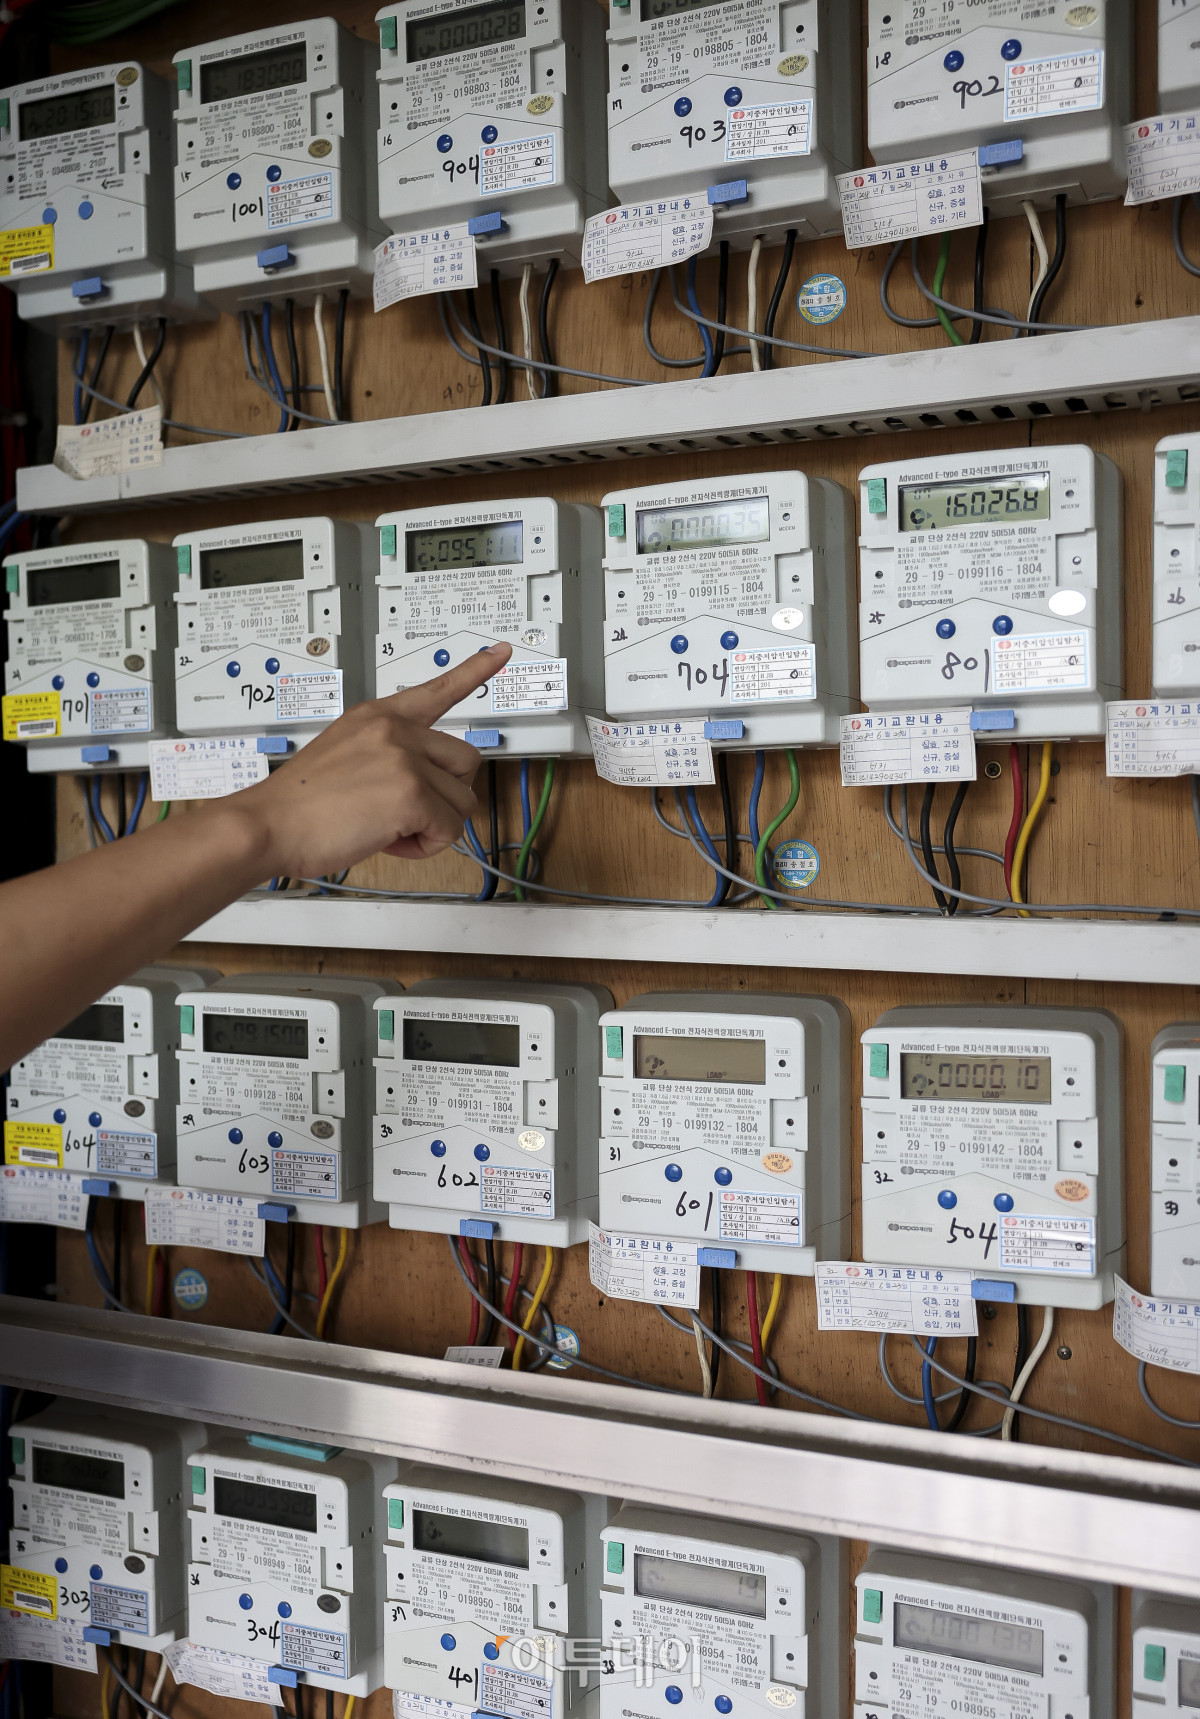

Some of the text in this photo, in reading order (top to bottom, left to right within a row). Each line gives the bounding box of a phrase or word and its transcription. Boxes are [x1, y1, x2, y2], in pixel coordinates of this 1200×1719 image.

[647, 32, 768, 69] 29 19 0198805 1804
[876, 52, 891, 68] 18
[412, 75, 520, 107] 29 19 0198803 1804
[953, 76, 1004, 109] 902
[205, 118, 302, 146] 29 19 0198800 1804
[384, 134, 392, 146] 16
[680, 120, 726, 148] 903
[181, 172, 191, 182] 15
[443, 154, 479, 184] 904
[233, 197, 263, 222] 1001
[899, 472, 933, 482] Advanced
[935, 471, 959, 479] E-type
[636, 498, 667, 508] Advanced
[668, 496, 689, 504] E-type
[910, 536, 925, 544] 교류
[928, 534, 944, 543] 단상
[946, 532, 967, 541] 2선식
[969, 531, 989, 539] 220V
[1018, 527, 1037, 535] 60Hz
[647, 557, 660, 565] 교류
[662, 556, 676, 564] 단상
[678, 554, 696, 562] 2선식
[699, 552, 716, 560] 220V
[742, 548, 758, 556] 60Hz
[905, 563, 1042, 583] 29 19 0199116 1804
[643, 581, 764, 602] 29 19 0199115 1804
[1167, 587, 1185, 604] 26
[411, 600, 517, 618] 29 19 0199114 1804
[869, 611, 885, 624] 25
[205, 614, 299, 632] 29 19 0199113 1804
[383, 643, 393, 656] 23
[180, 657, 192, 666] 22
[678, 658, 729, 697] 704
[942, 649, 989, 693] 801
[242, 685, 275, 710] 702
[63, 693, 88, 723] 701
[945, 765, 960, 773] 기타
[900, 1043, 935, 1051] Advanced
[937, 1044, 960, 1052] E-type
[208, 1086, 303, 1102] 29 19 0199128 1804
[642, 1083, 656, 1091] 교류
[658, 1084, 672, 1092] 단상
[674, 1085, 692, 1093] 2선식
[695, 1086, 712, 1094] 220V
[737, 1088, 754, 1096] 60Hz
[407, 1095, 513, 1112] 29 19 0199131 1804
[912, 1104, 927, 1113] 교류
[930, 1105, 945, 1114] 단상
[948, 1106, 968, 1114] 2선식
[971, 1107, 990, 1115] 220V
[1019, 1109, 1038, 1117] 60Hz
[183, 1114, 194, 1126] 29
[639, 1116, 758, 1133] 29 19 0199132 1804
[381, 1124, 392, 1138] 30
[65, 1130, 96, 1168] 604
[610, 1147, 620, 1161] 31
[907, 1140, 1043, 1156] 29 19 0199142 1804
[239, 1149, 269, 1173] 603
[438, 1164, 479, 1187] 602
[874, 1170, 893, 1184] 32
[676, 1191, 713, 1231] 601
[947, 1218, 998, 1259] 504
[217, 1548, 227, 1561] 29
[236, 1552, 245, 1561] 19
[294, 1561, 312, 1575] 1804
[191, 1573, 199, 1585] 36
[60, 1586, 90, 1613] 303
[418, 1586, 523, 1614] 29 19 0198950 1804
[392, 1606, 406, 1621] 37
[248, 1620, 280, 1648] 304
[602, 1660, 614, 1674] 38
[736, 1653, 758, 1666] 1804
[447, 1666, 478, 1702] 401
[899, 1688, 996, 1718] 29 19 0198955
